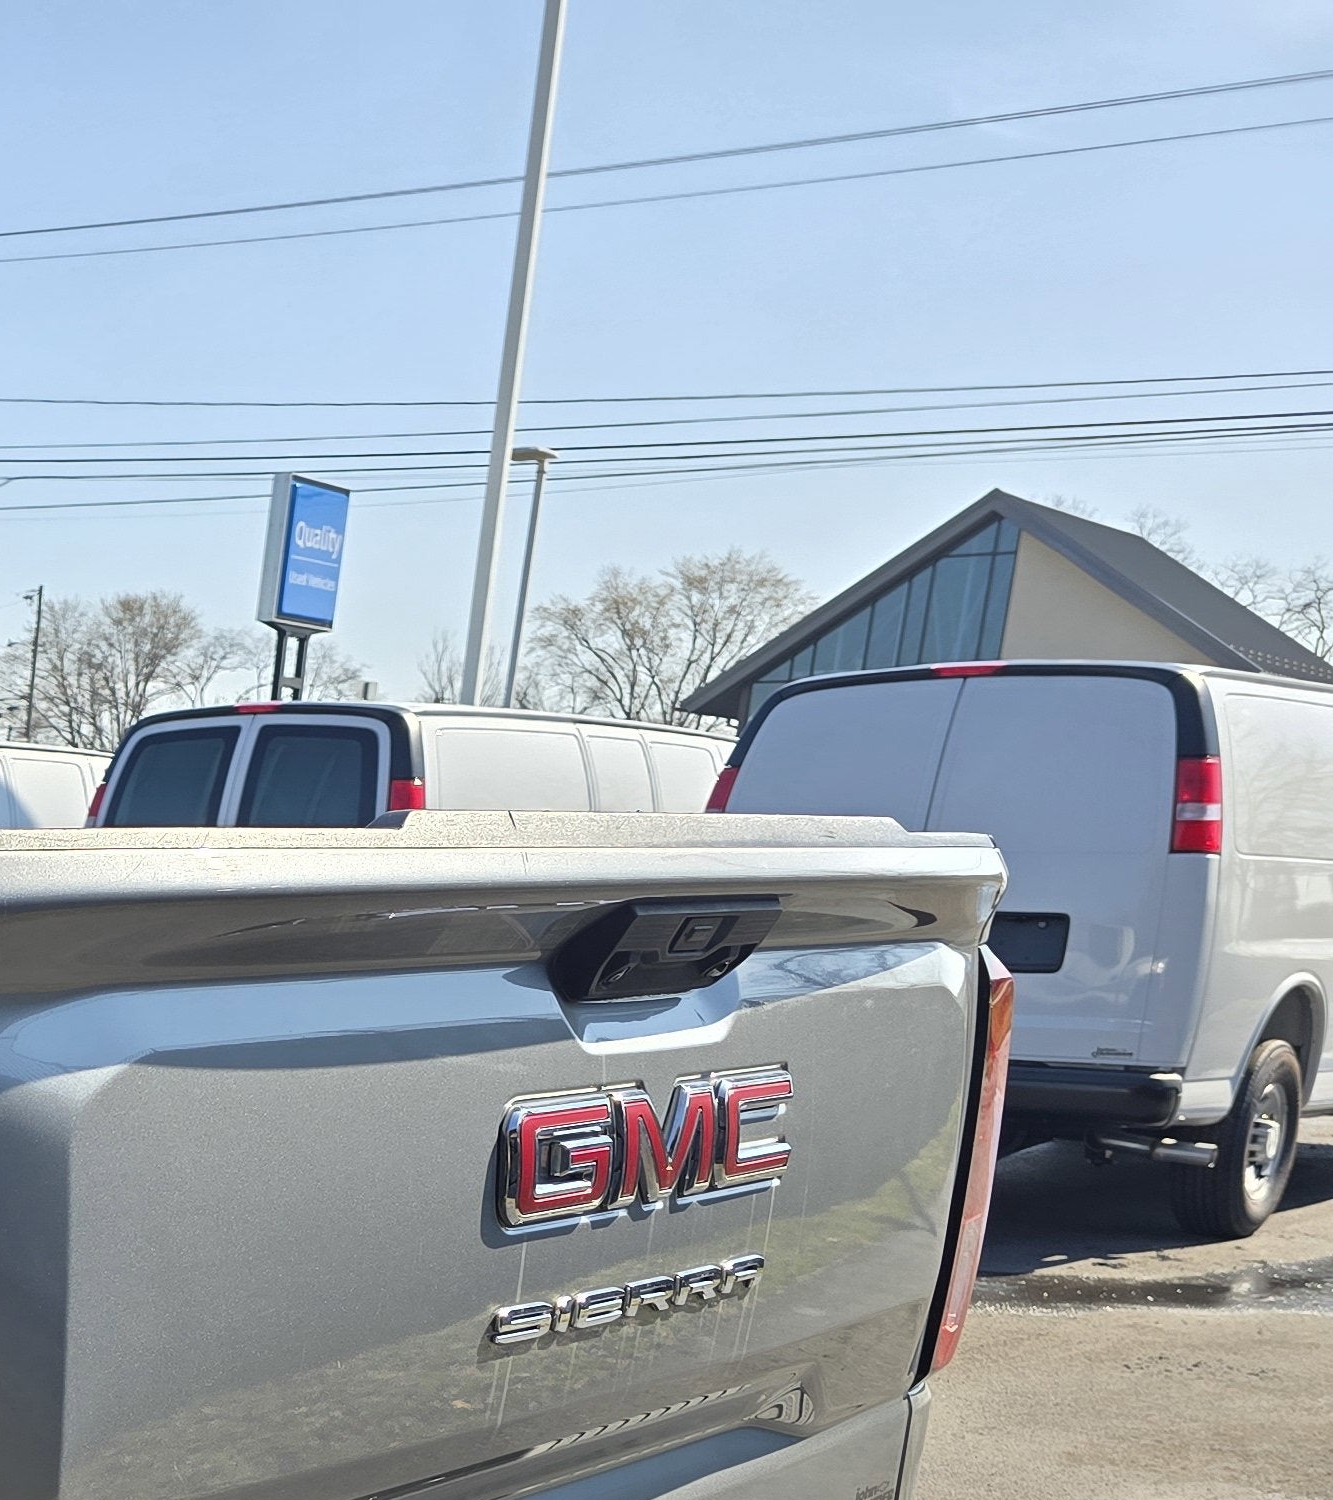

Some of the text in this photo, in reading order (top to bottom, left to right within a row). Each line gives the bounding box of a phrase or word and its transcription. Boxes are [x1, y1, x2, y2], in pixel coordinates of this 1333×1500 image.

[295, 521, 343, 559] Quality
[495, 1062, 793, 1236] GMC
[489, 1253, 766, 1346] SIERRA
